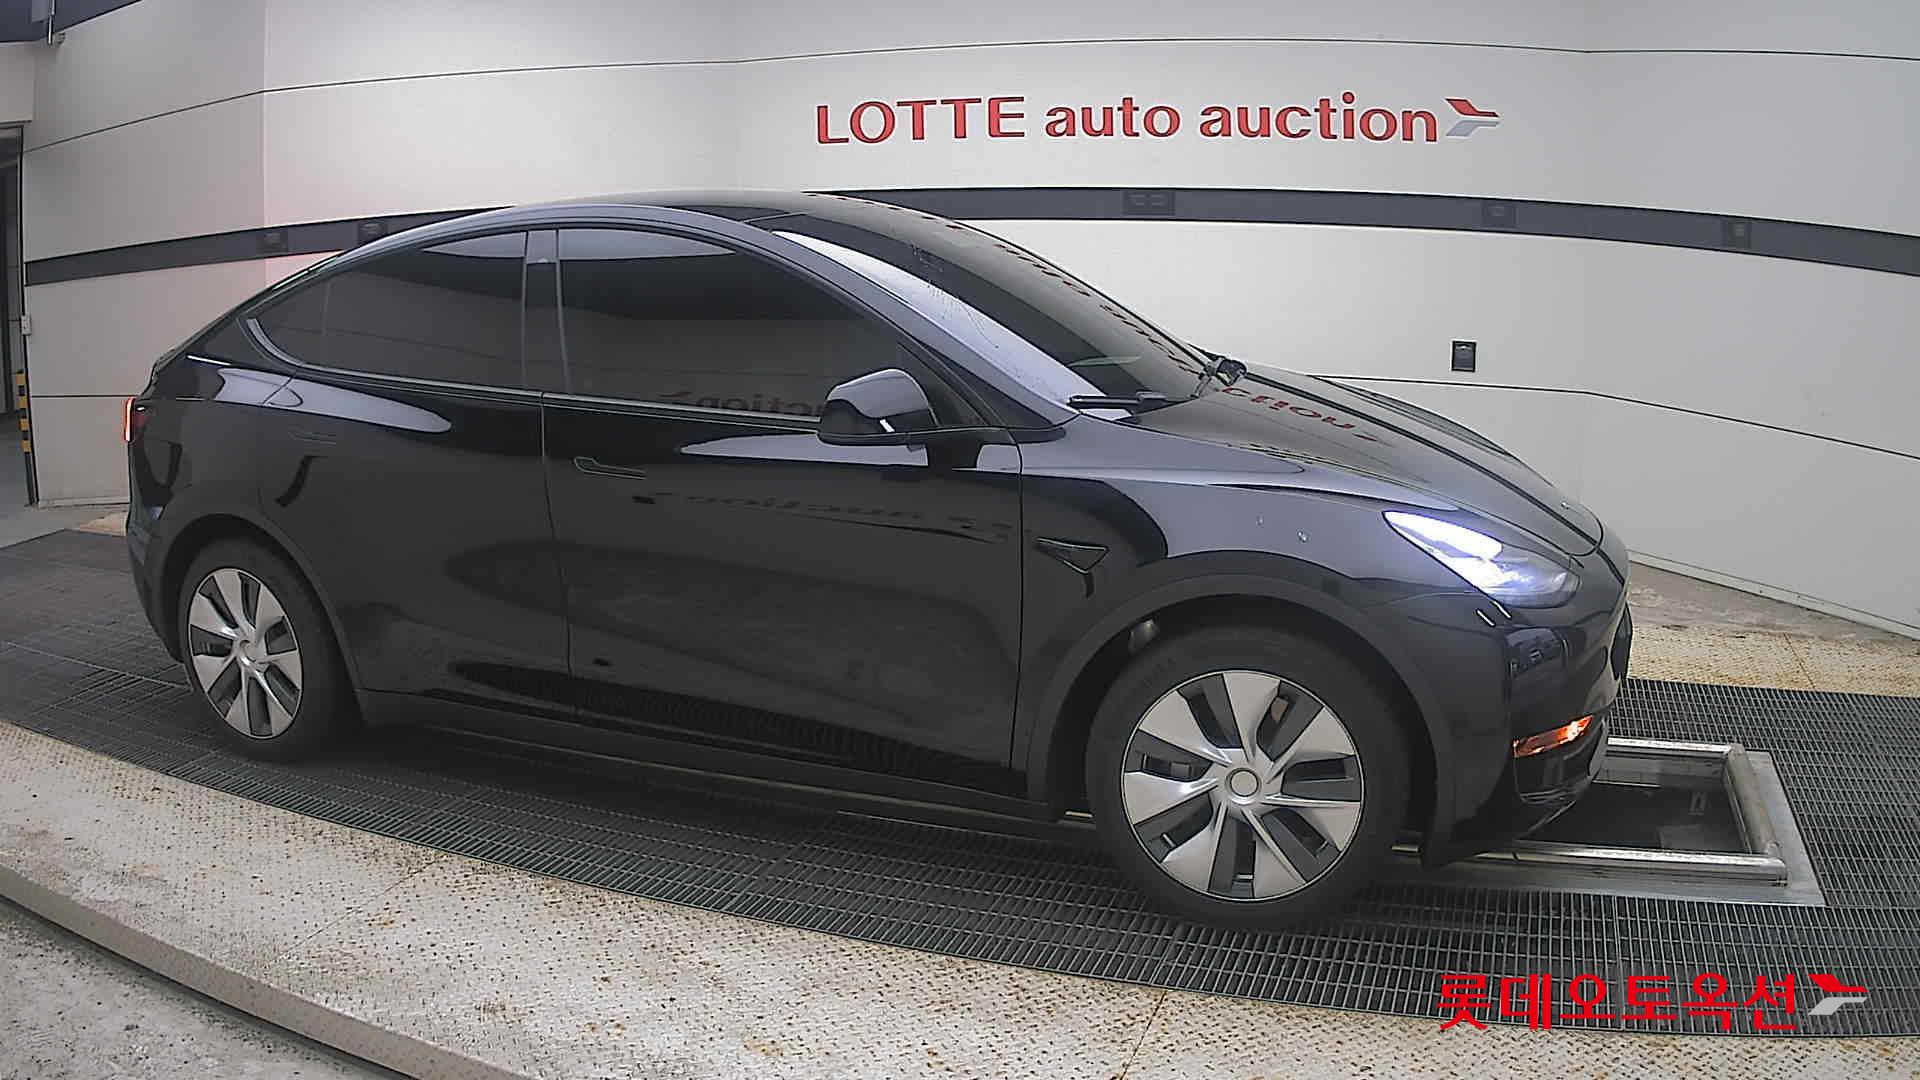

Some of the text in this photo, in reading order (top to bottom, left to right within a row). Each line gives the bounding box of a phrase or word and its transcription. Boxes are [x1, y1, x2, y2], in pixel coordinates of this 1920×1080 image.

[816, 93, 1438, 144] LOTTE auto auction
